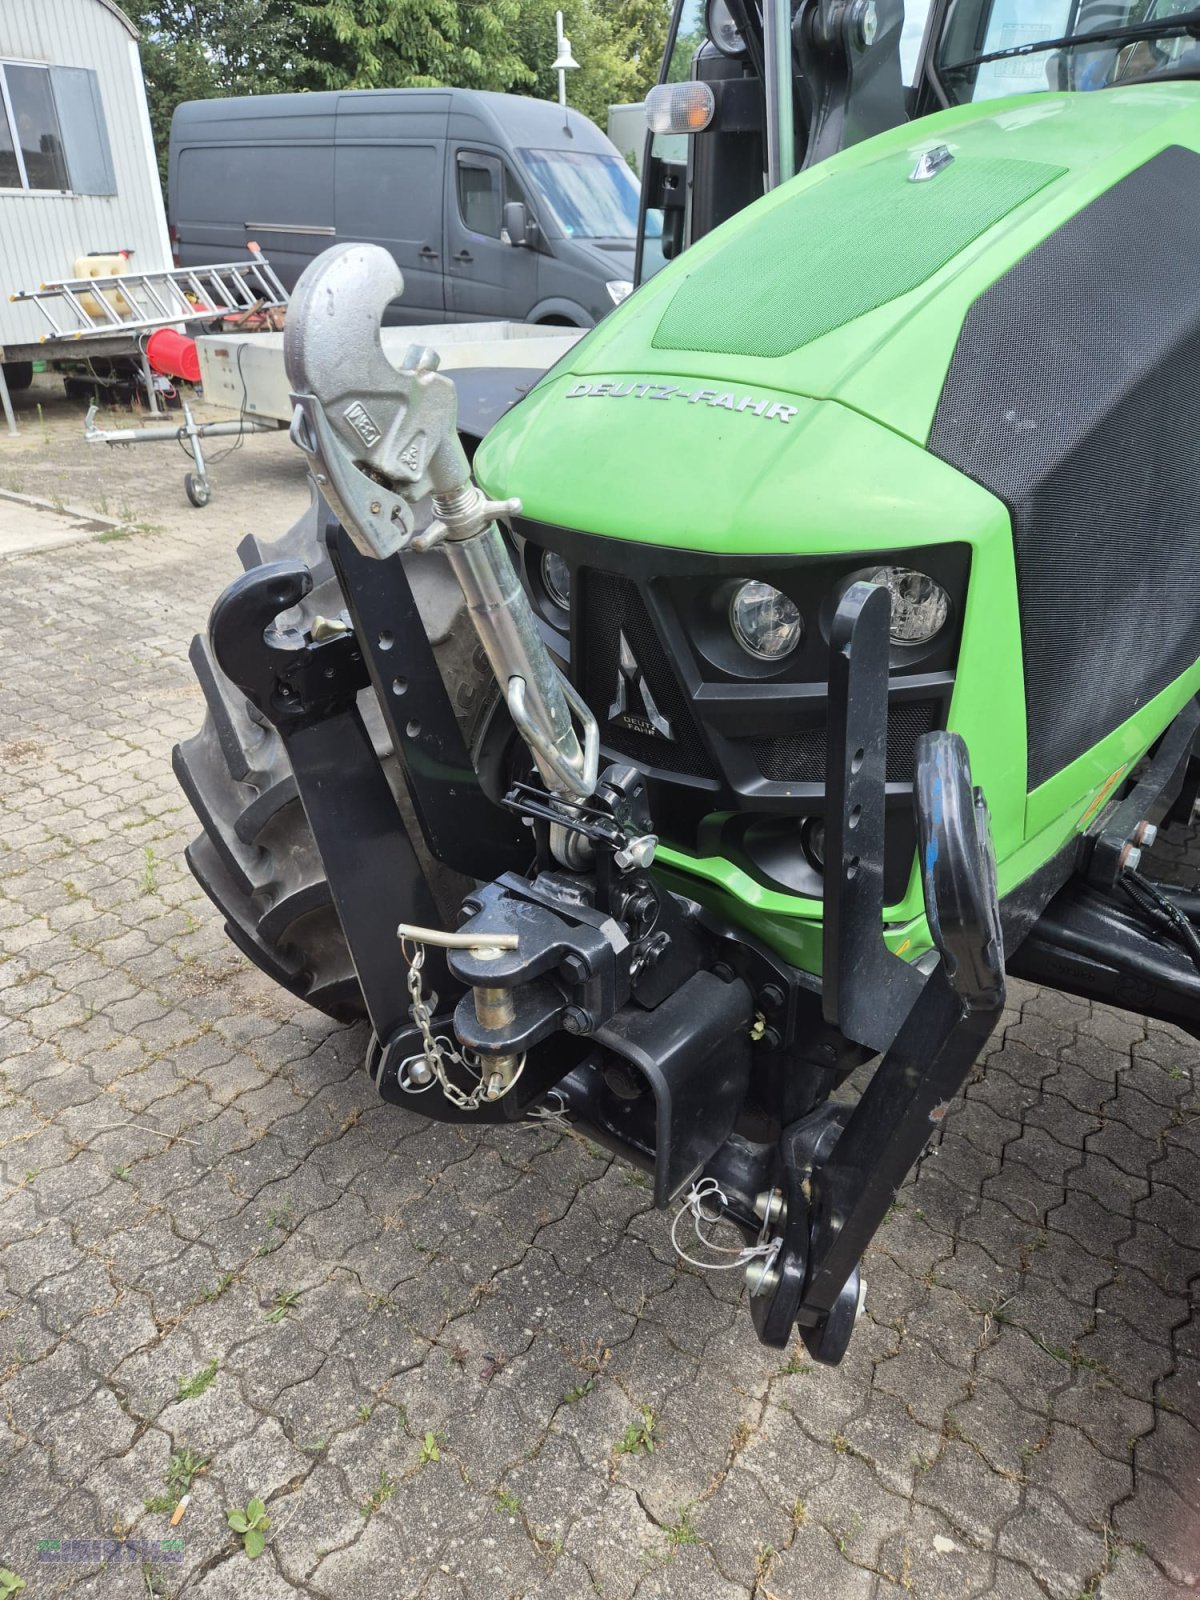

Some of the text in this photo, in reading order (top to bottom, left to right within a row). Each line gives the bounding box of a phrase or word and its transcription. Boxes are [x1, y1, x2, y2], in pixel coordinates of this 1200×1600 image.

[566, 382, 799, 424] DEUTZ-FAHR
[623, 716, 656, 731] DEUTZ
[627, 723, 656, 736] FAHR
